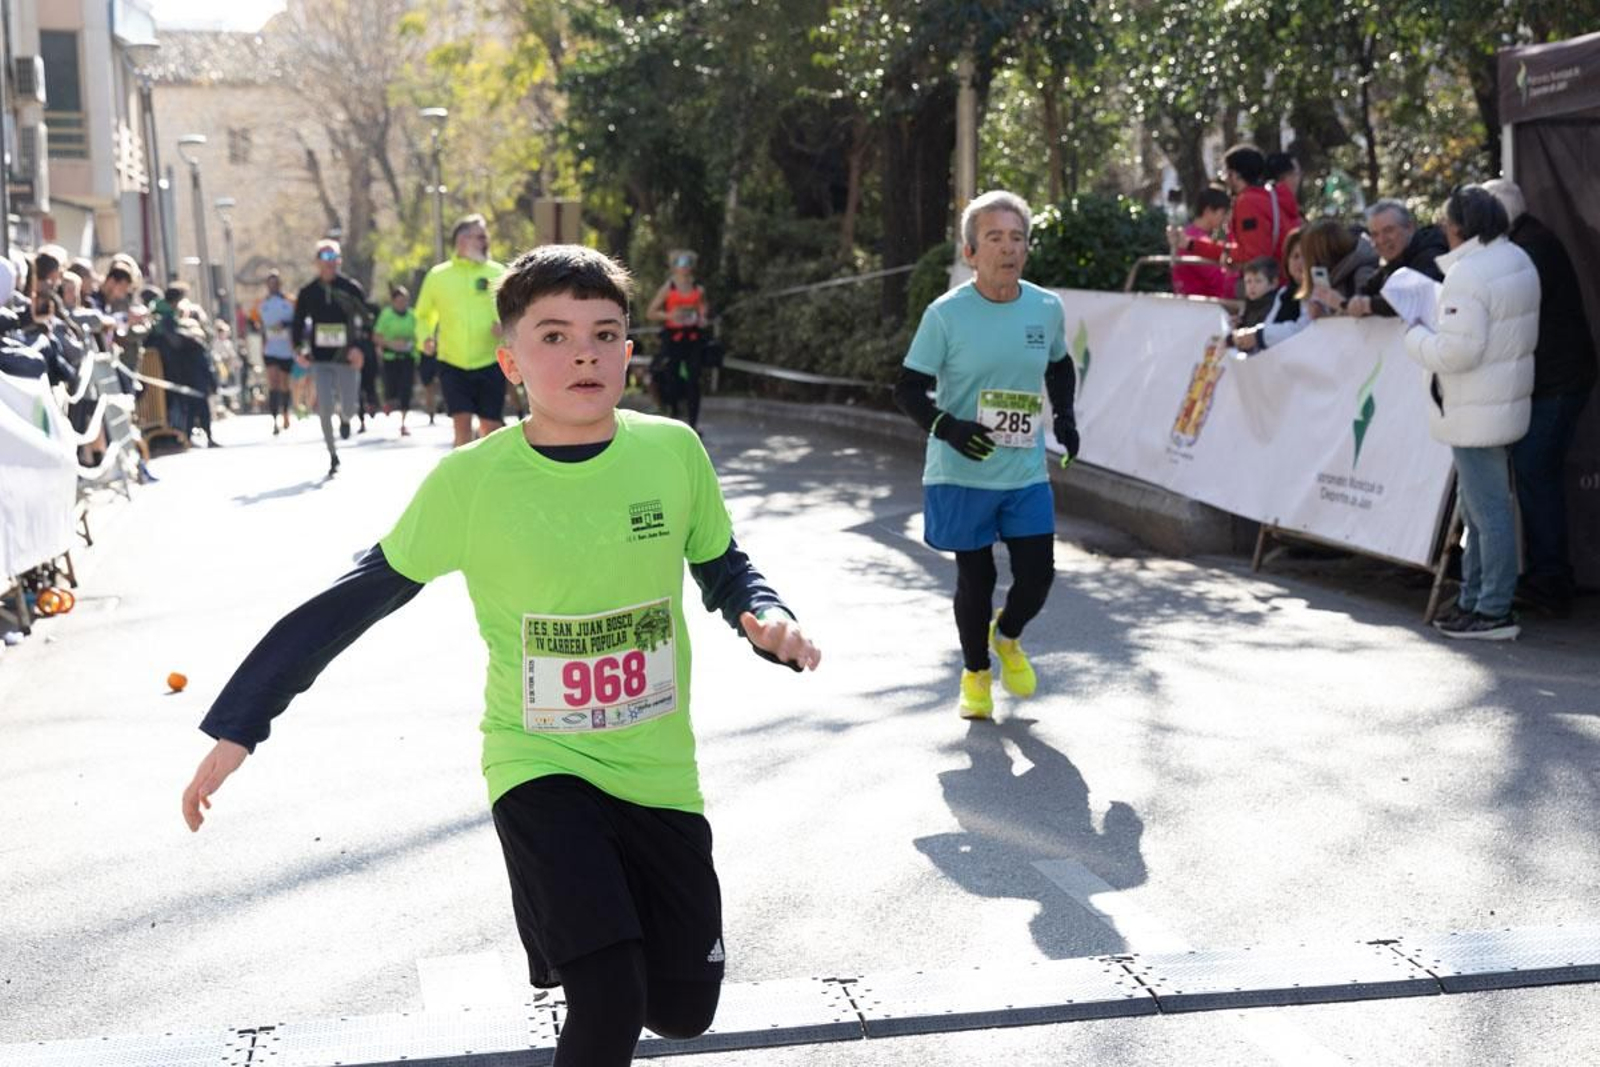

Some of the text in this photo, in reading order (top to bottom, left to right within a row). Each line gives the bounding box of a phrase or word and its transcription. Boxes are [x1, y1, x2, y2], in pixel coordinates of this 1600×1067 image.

[995, 411, 1031, 434] 285
[553, 621, 573, 637] SAN
[576, 619, 603, 637] JUAN
[606, 613, 633, 632] BOSCO
[547, 637, 588, 655] CARRERA
[590, 630, 628, 653] POPULAR
[562, 651, 647, 708] 968
